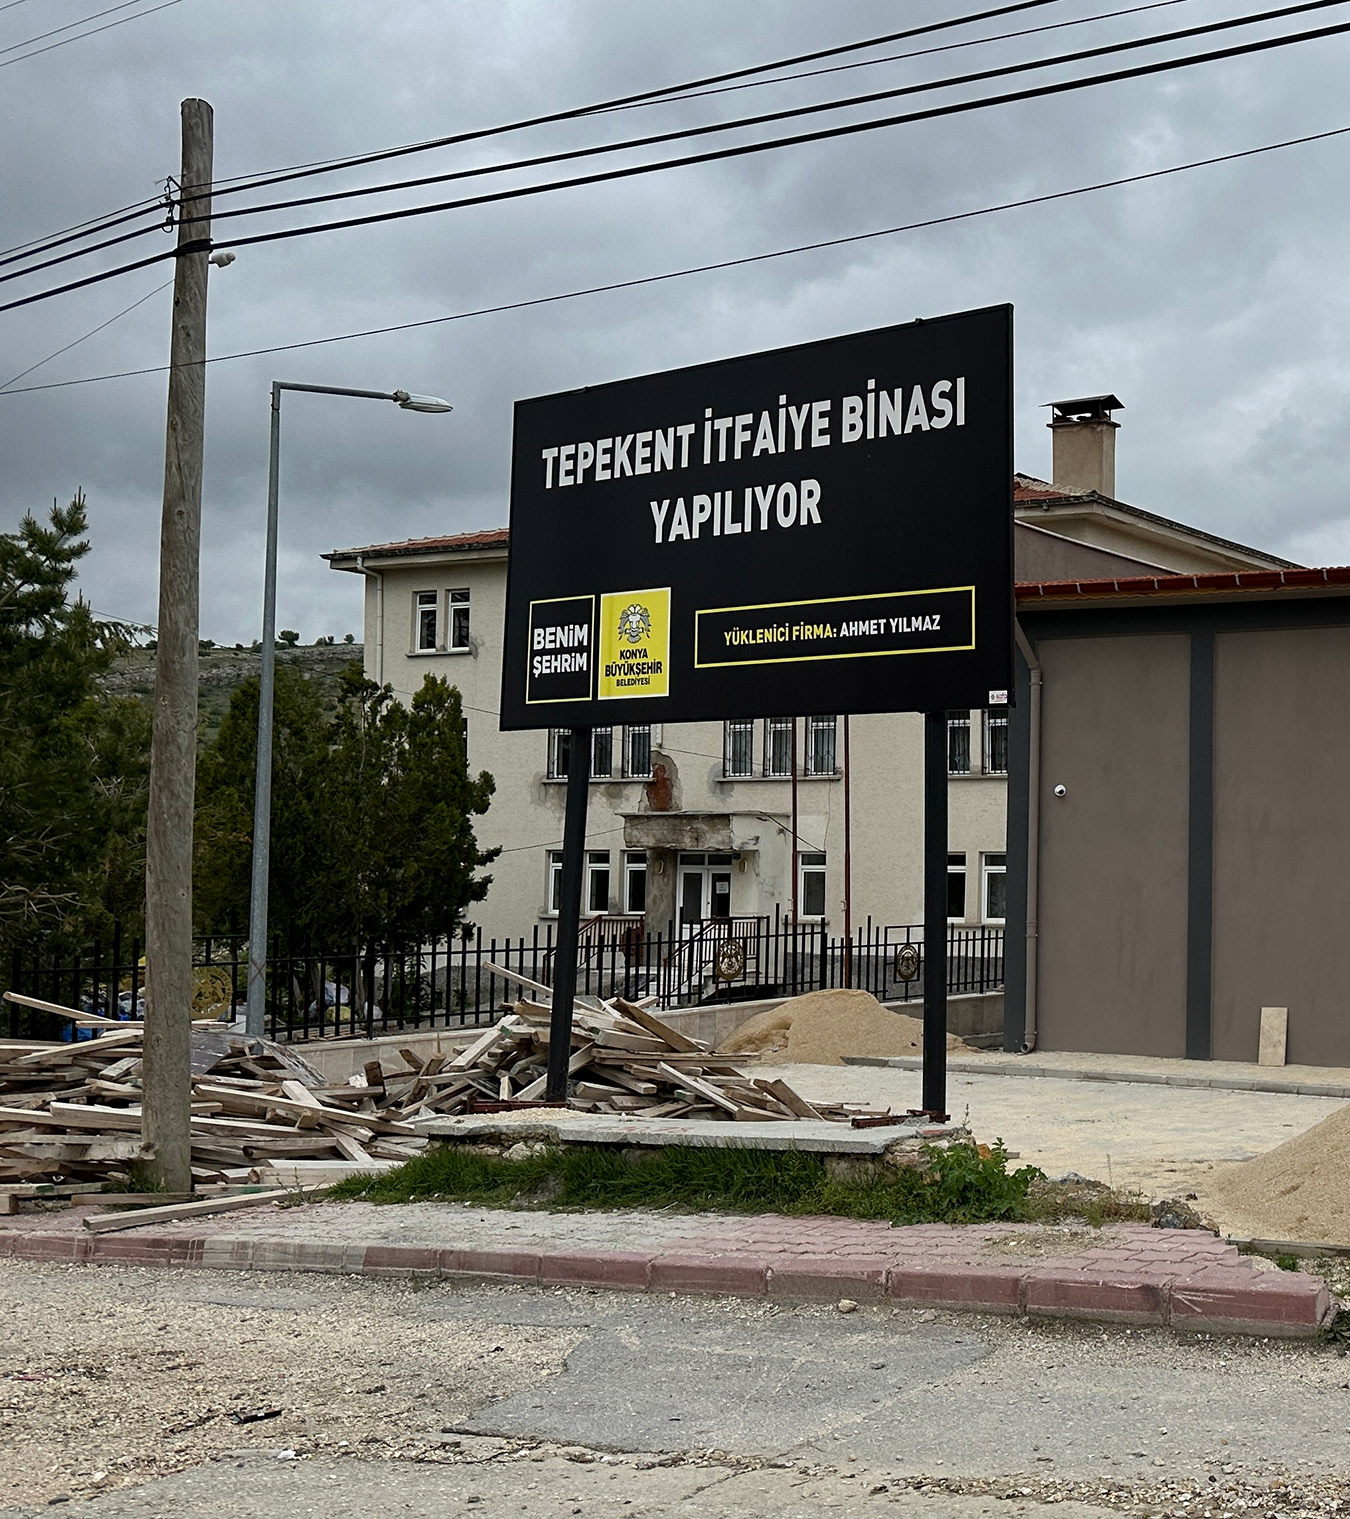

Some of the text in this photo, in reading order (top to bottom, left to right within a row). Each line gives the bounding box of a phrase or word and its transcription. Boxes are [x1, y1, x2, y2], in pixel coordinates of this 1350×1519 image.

[541, 376, 966, 489] TEPEKENT İTFAİYE BİNASI
[650, 478, 822, 544] YAPILIYOR
[724, 615, 941, 646] YÜKLENİCİ FİRMA: AHMET YILMAZ
[619, 648, 648, 660] KONYA
[605, 659, 663, 677] BÜYÜKŞEHİR
[616, 676, 651, 687] BELEDİYESİ
